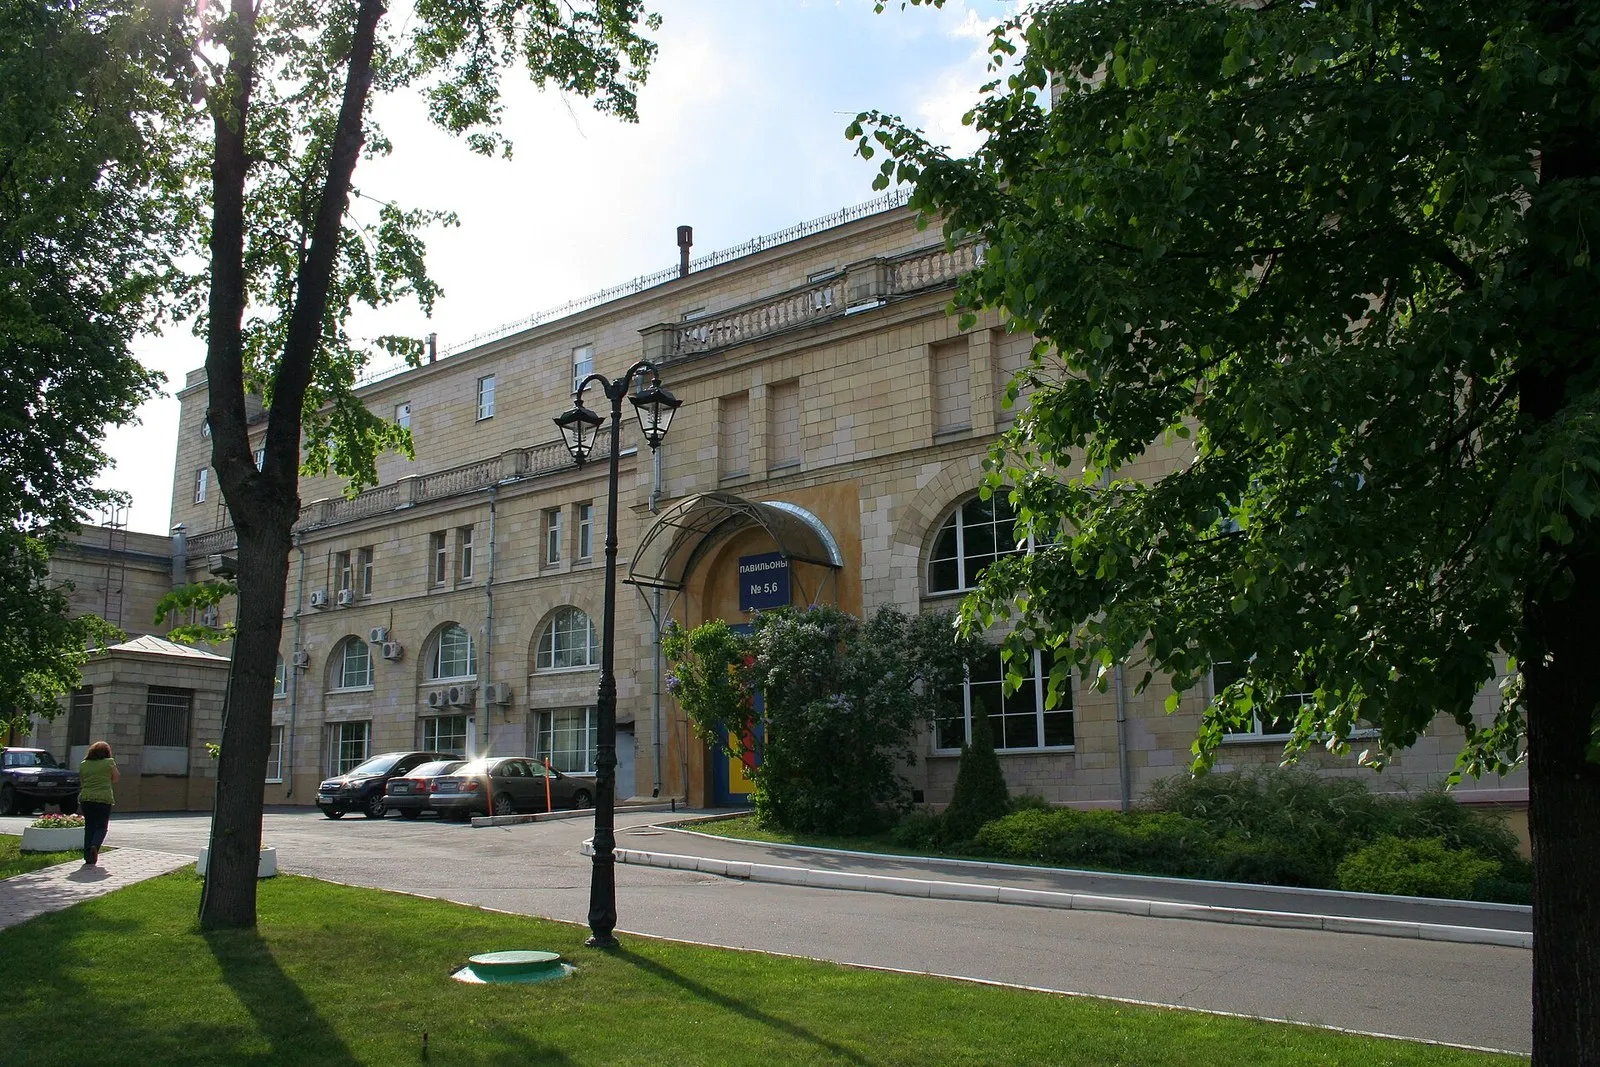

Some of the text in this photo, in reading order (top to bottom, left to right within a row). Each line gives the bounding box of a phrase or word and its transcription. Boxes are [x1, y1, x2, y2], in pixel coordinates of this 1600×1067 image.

[740, 560, 788, 573] ПАВИЛЬОНЫ
[750, 582, 778, 595] № 5,6
